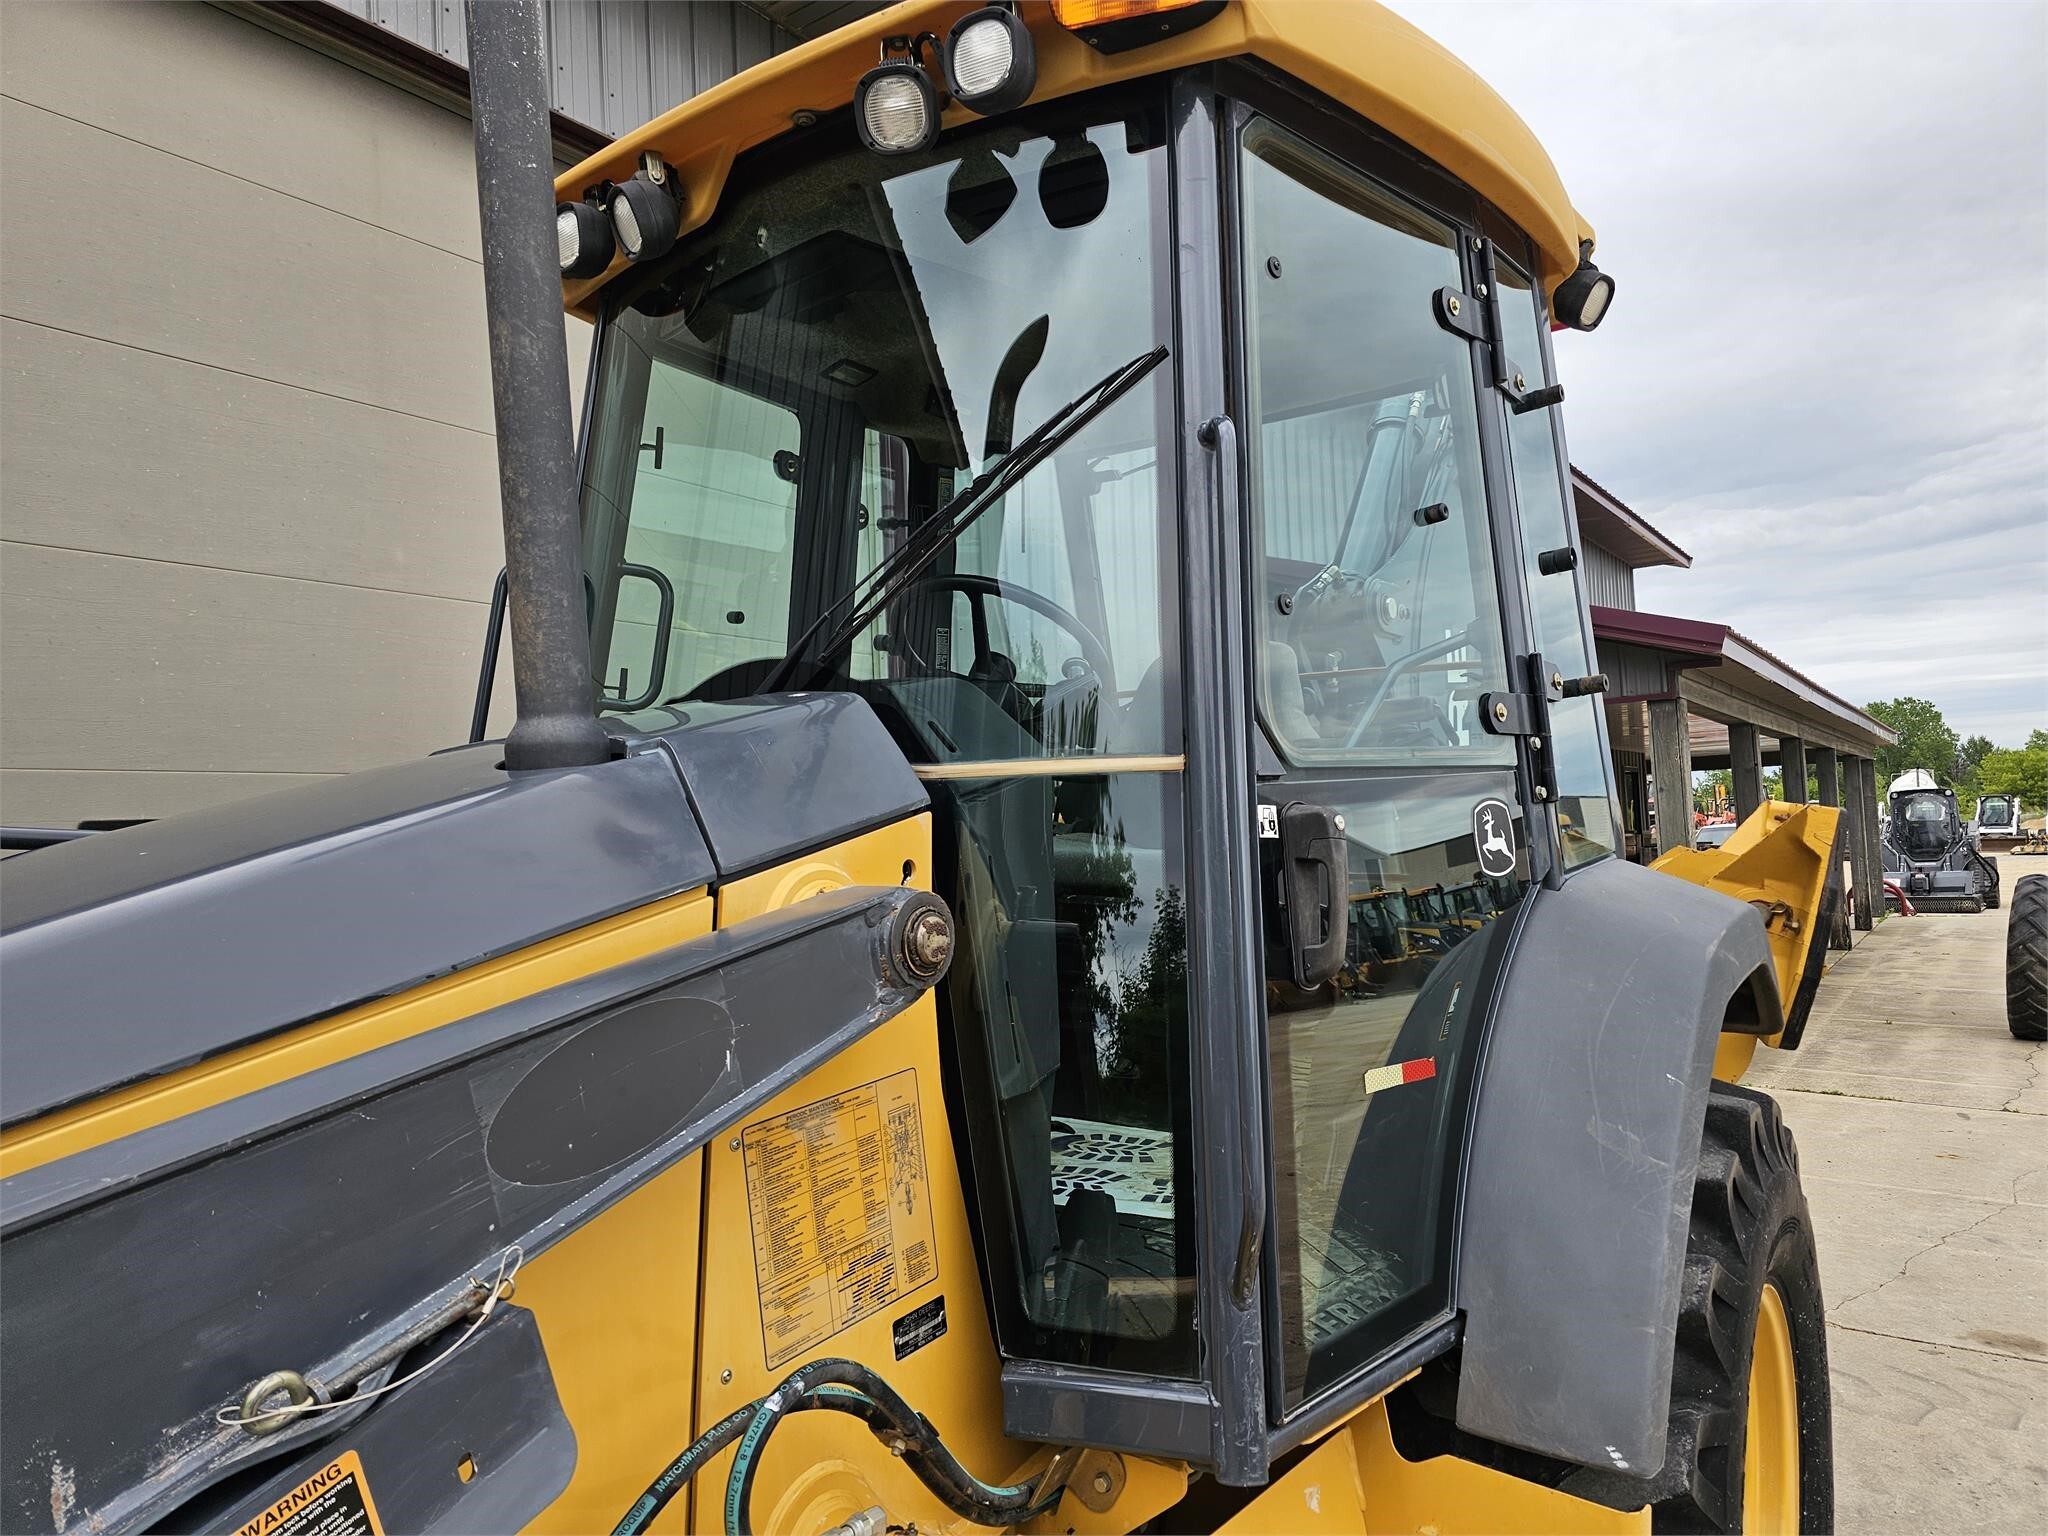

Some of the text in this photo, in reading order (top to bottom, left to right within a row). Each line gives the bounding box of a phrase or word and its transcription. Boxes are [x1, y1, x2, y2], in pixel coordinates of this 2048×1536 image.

[789, 1365, 814, 1383] PLUS
[654, 1439, 709, 1493] MATCHMATE
[707, 1420, 732, 1442] PLUS
[740, 1411, 767, 1461] GH781-8
[240, 1463, 342, 1536] WARNING
[283, 1514, 301, 1530] lock
[300, 1497, 325, 1518] before
[324, 1476, 353, 1500] working
[307, 1506, 324, 1521] with
[323, 1497, 337, 1509] the
[728, 1469, 743, 1517] 12.7mm
[319, 1511, 340, 1530] place
[339, 1505, 348, 1514] in
[327, 1515, 345, 1531] until
